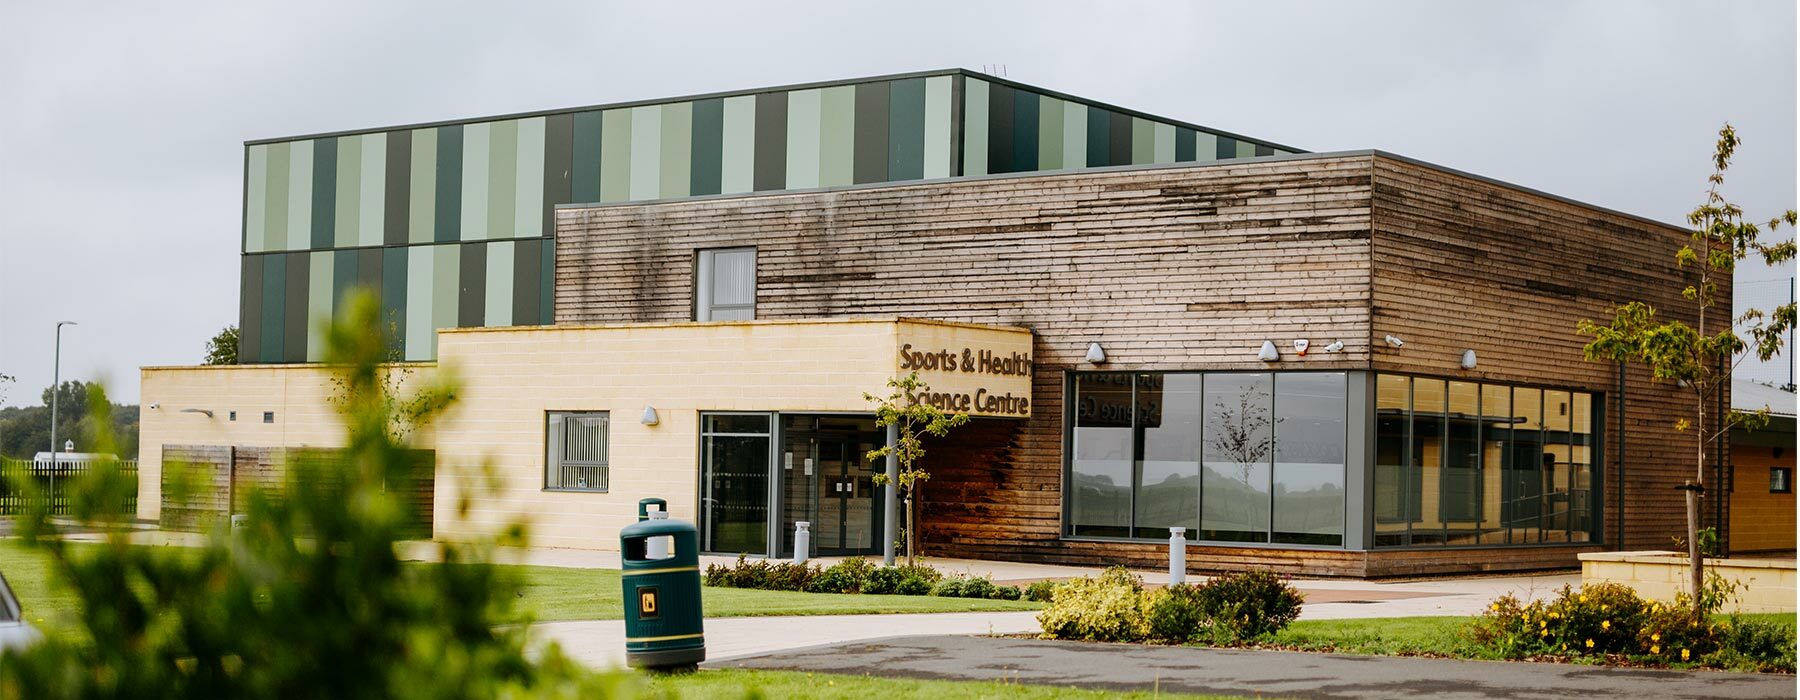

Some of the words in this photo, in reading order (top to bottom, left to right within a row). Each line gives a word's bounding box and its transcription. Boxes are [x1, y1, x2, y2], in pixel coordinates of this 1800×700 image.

[900, 343, 957, 372] Sports
[960, 348, 975, 373] &
[978, 349, 1032, 377] Health
[974, 387, 1029, 414] Centre
